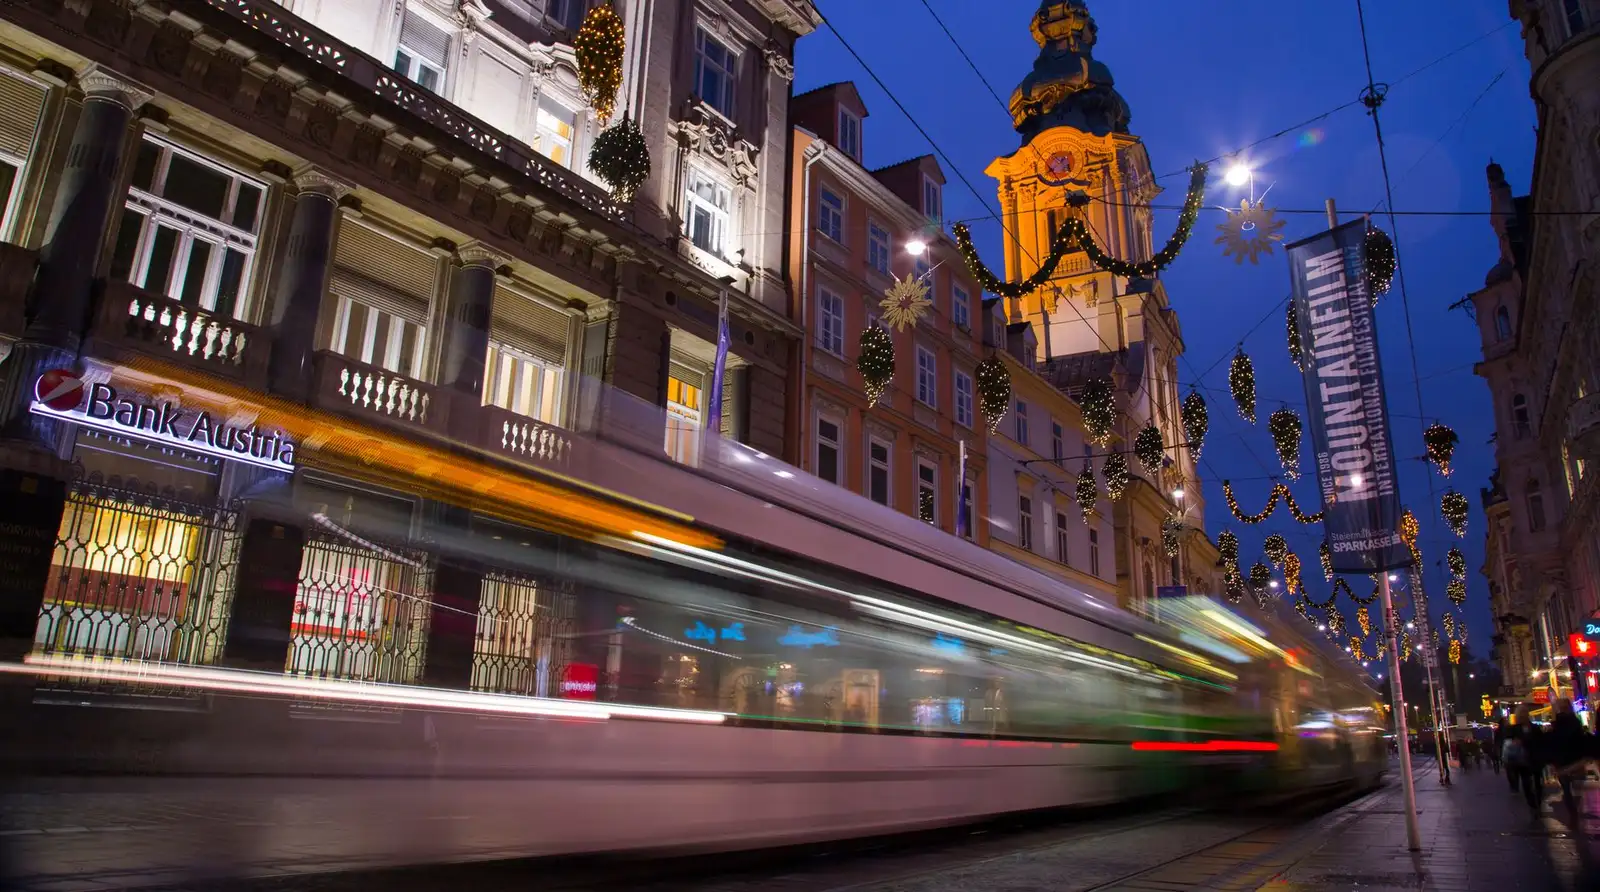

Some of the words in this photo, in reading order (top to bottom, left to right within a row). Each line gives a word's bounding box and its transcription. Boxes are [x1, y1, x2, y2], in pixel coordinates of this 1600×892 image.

[1348, 279, 1378, 376] FILMFESTIVAL
[1305, 248, 1378, 503] MOUNTAINFILM
[86, 382, 181, 439] Bank
[187, 411, 295, 466] Austria
[1317, 452, 1331, 473] 1986
[1361, 377, 1394, 496] INTERNATIONAL
[1321, 476, 1335, 504] SINCE
[1333, 536, 1392, 552] SPARKASSE
